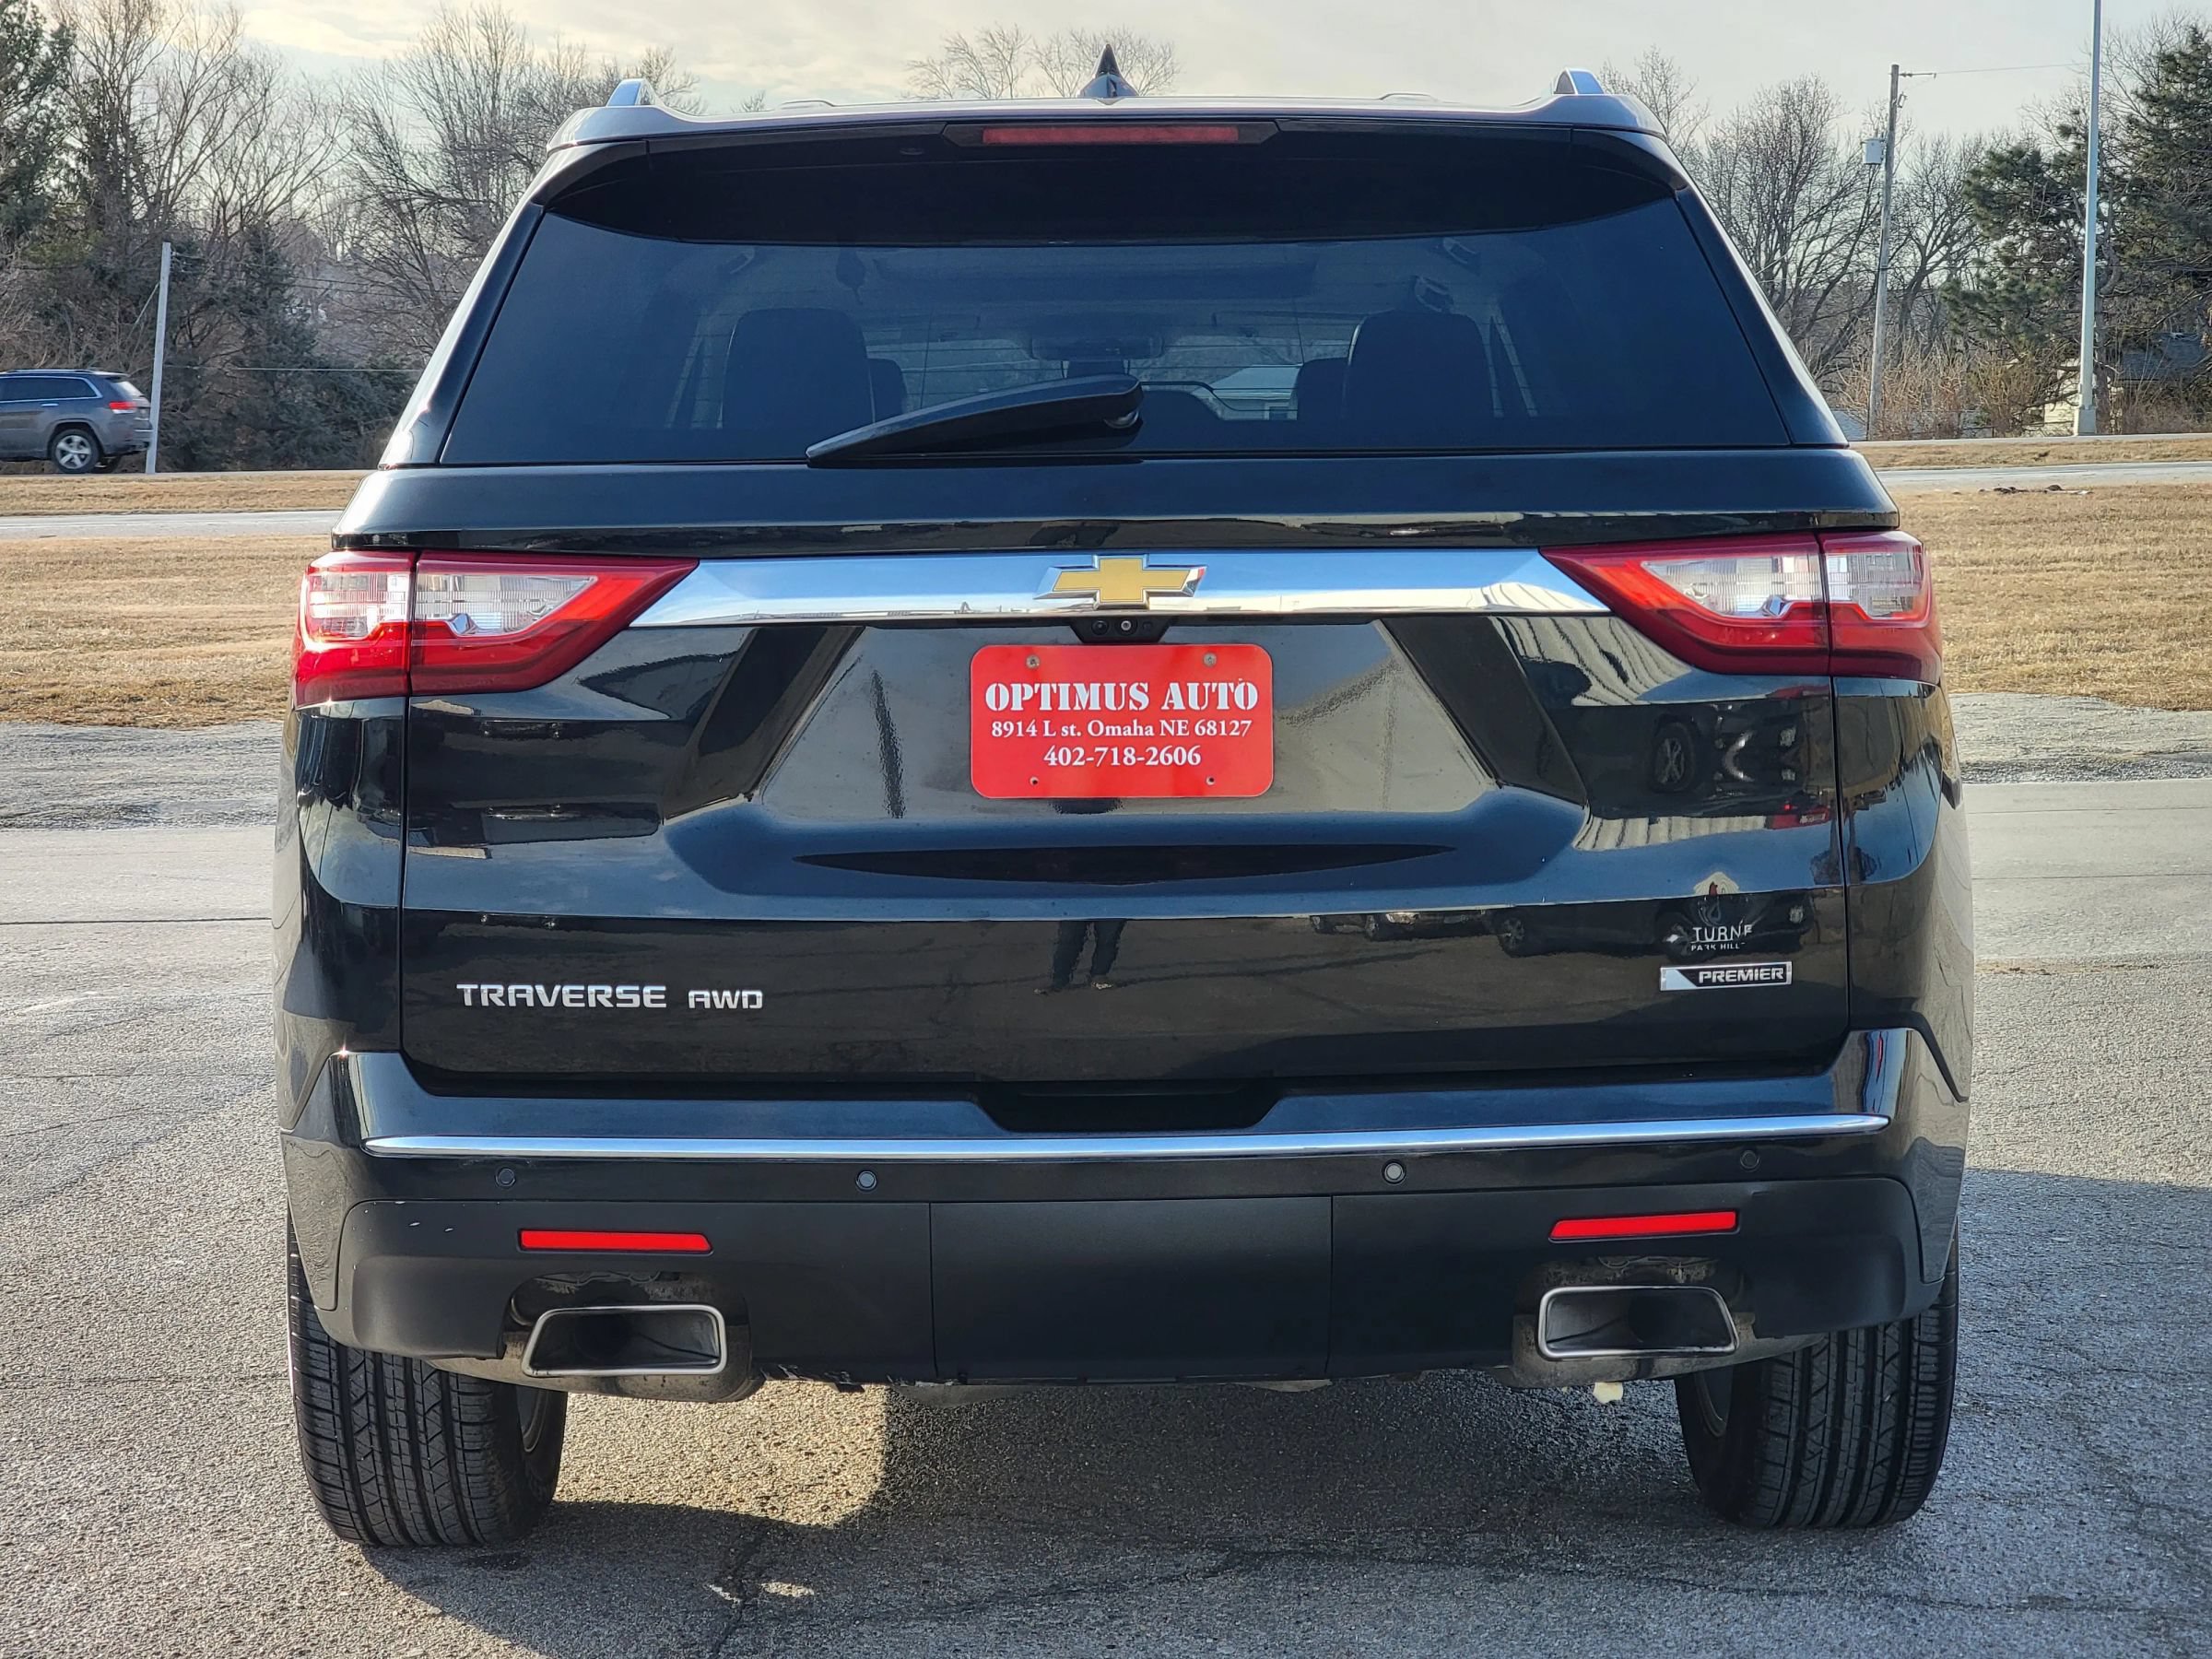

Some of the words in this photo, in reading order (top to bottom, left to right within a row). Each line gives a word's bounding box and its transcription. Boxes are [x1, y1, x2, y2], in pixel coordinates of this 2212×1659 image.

[985, 682, 1149, 712] OPTIMUS
[1161, 682, 1259, 712] AUTO
[991, 720, 1038, 737] 8914
[1042, 720, 1056, 737] L
[1061, 721, 1082, 737] st.
[1088, 719, 1154, 737] Omaha
[1159, 720, 1190, 737] NE
[1194, 719, 1252, 738] 68127
[1043, 745, 1201, 768] 402-718-2606
[1690, 944, 1717, 952] PARK
[1699, 967, 1784, 983] PREMIER
[456, 984, 666, 1008] TRAVERSE
[688, 990, 763, 1009] AWD
